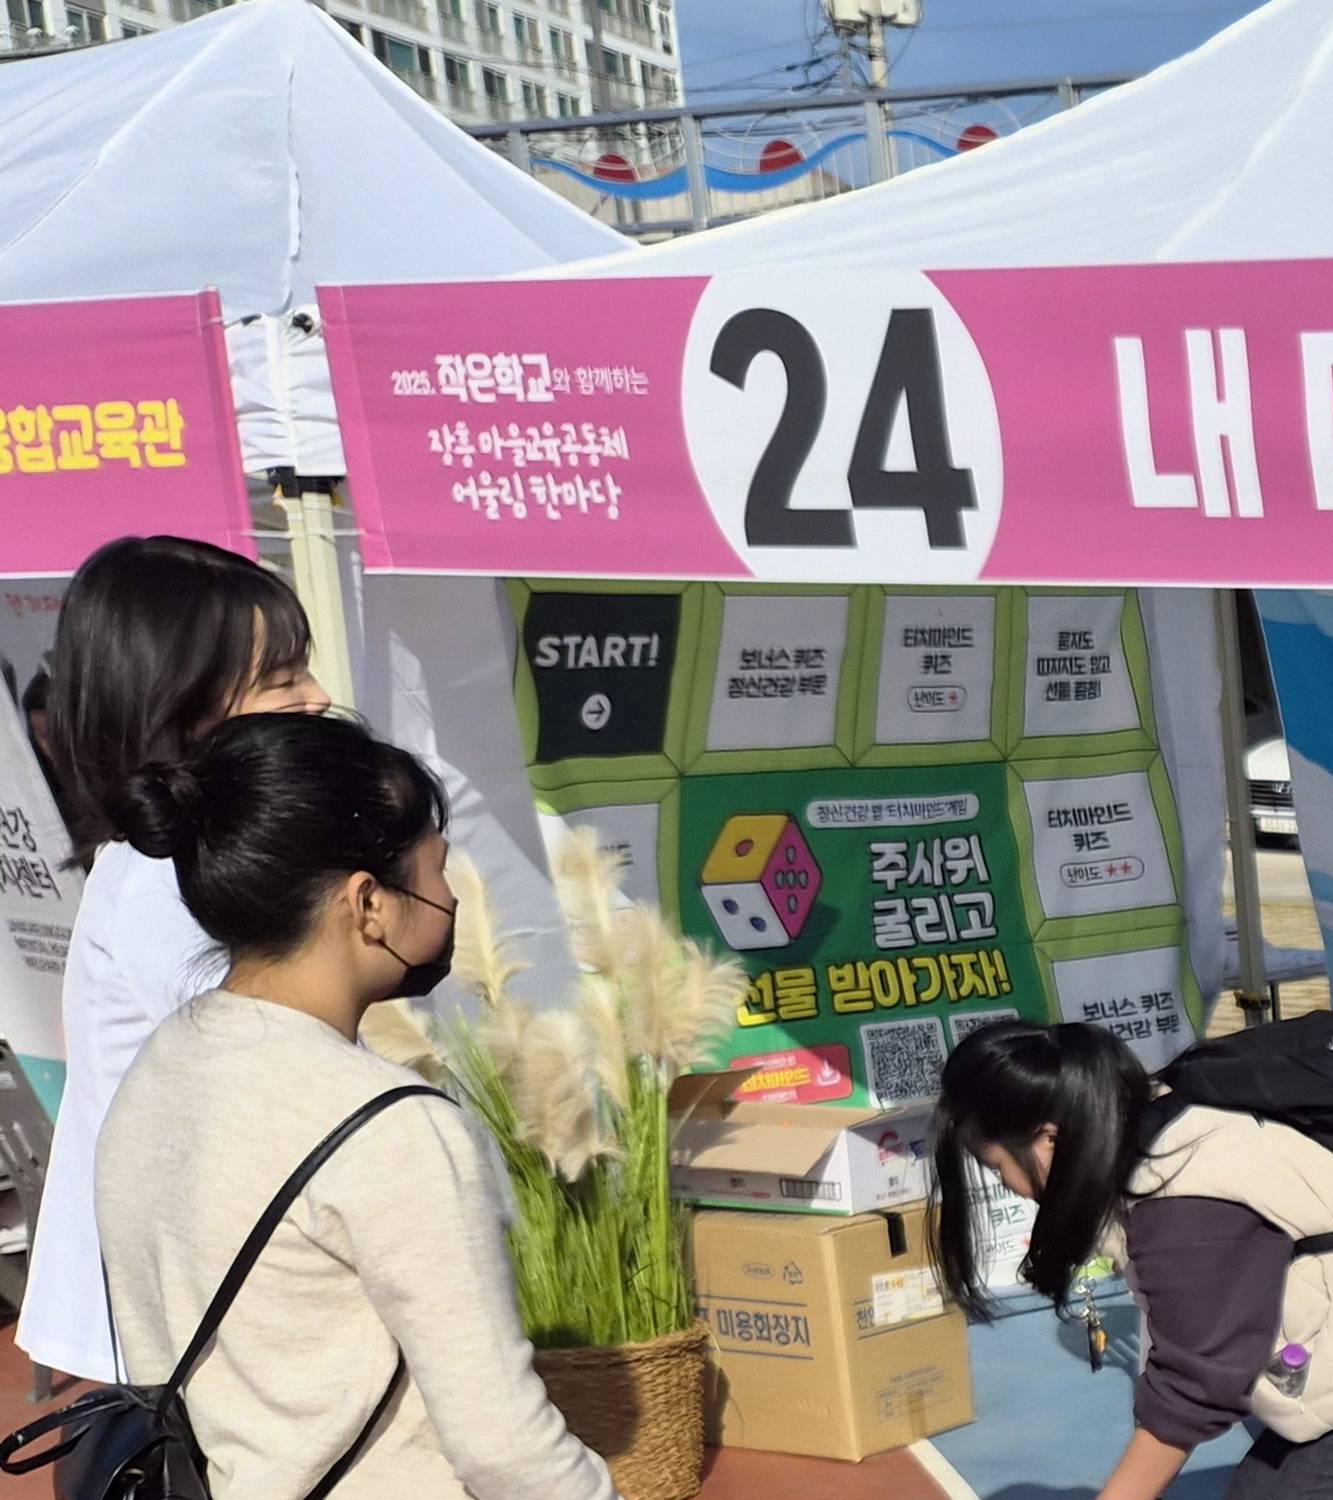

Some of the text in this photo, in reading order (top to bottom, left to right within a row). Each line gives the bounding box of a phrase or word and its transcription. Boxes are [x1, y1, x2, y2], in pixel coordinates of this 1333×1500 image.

[574, 365, 649, 396] 함께하는
[709, 308, 980, 550] 24
[1113, 326, 1264, 518] 내
[427, 421, 630, 468] 장흥 마을교육공동체
[452, 470, 624, 520] 어울림 한마당
[534, 633, 659, 669] START!
[903, 627, 975, 648] 터치마인드
[921, 653, 953, 675] 퀴즈
[1048, 802, 1133, 829] 터치마인드
[1073, 831, 1111, 852] 퀴즈
[870, 834, 991, 891] 주사위
[873, 891, 997, 950] 굴리고
[828, 949, 1012, 1014] 받아가자!
[1083, 991, 1174, 1022] 보너스 퀴즈
[716, 1308, 811, 1348] 미용화장지
